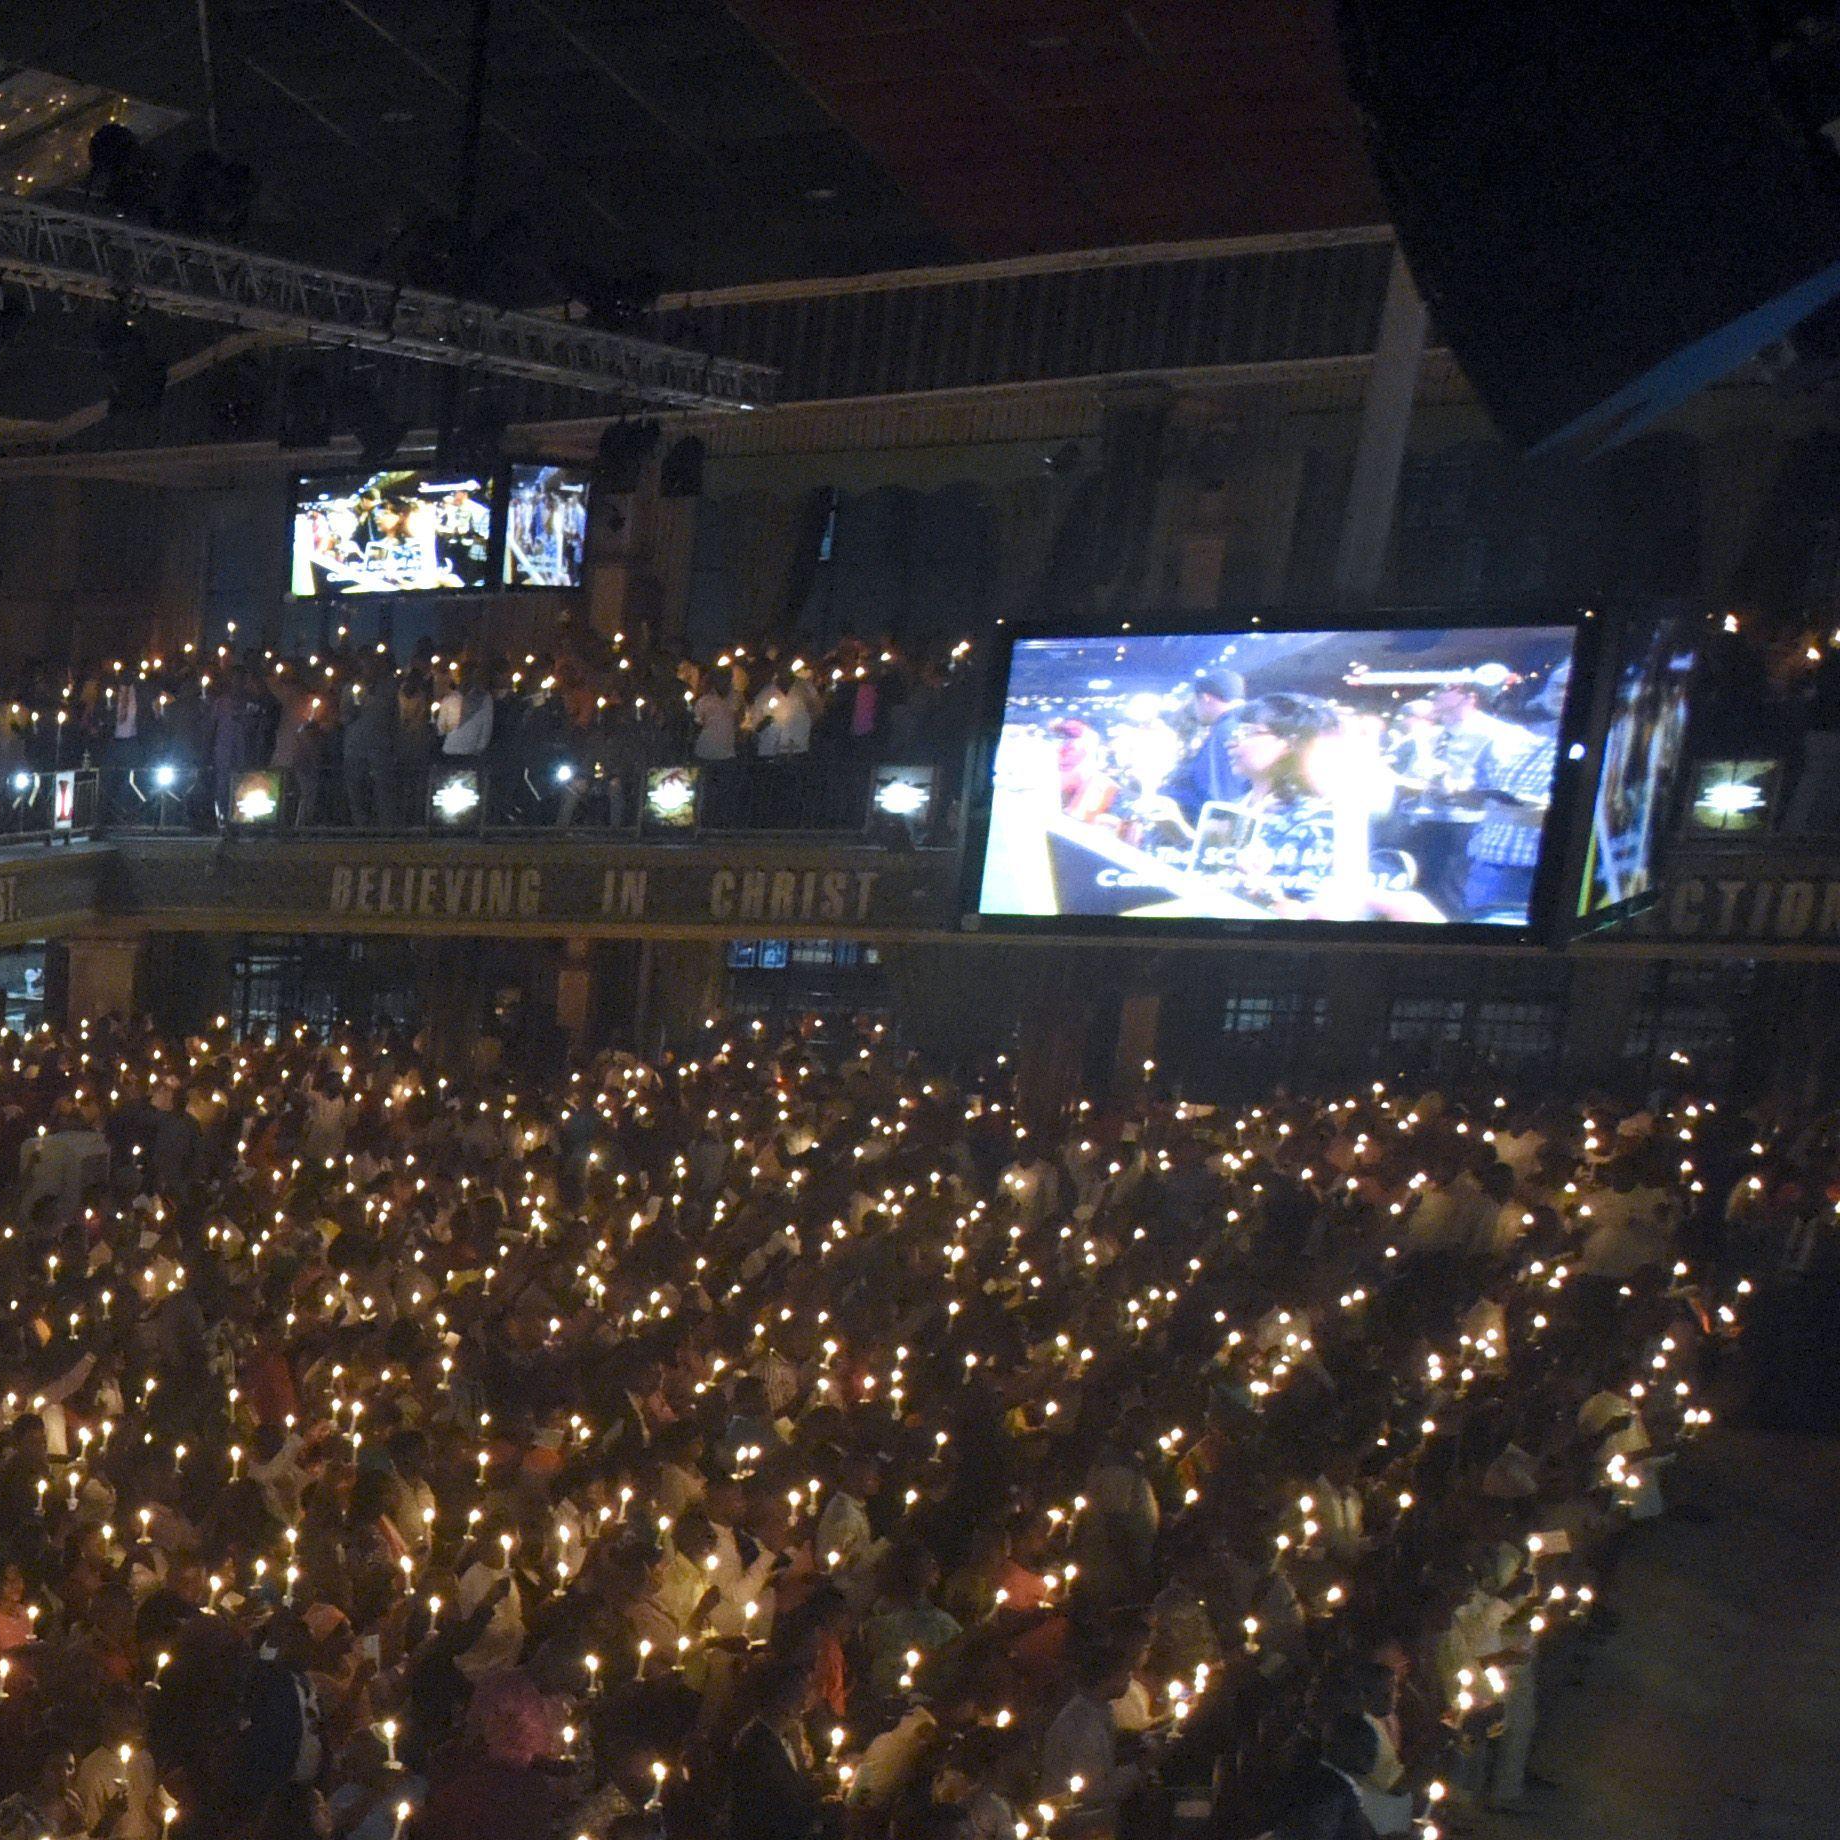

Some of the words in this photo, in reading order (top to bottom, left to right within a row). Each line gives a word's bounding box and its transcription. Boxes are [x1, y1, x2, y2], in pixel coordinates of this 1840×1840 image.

[331, 866, 543, 918] BELIEVING
[600, 869, 649, 917] IN
[709, 868, 880, 920] CHRIST
